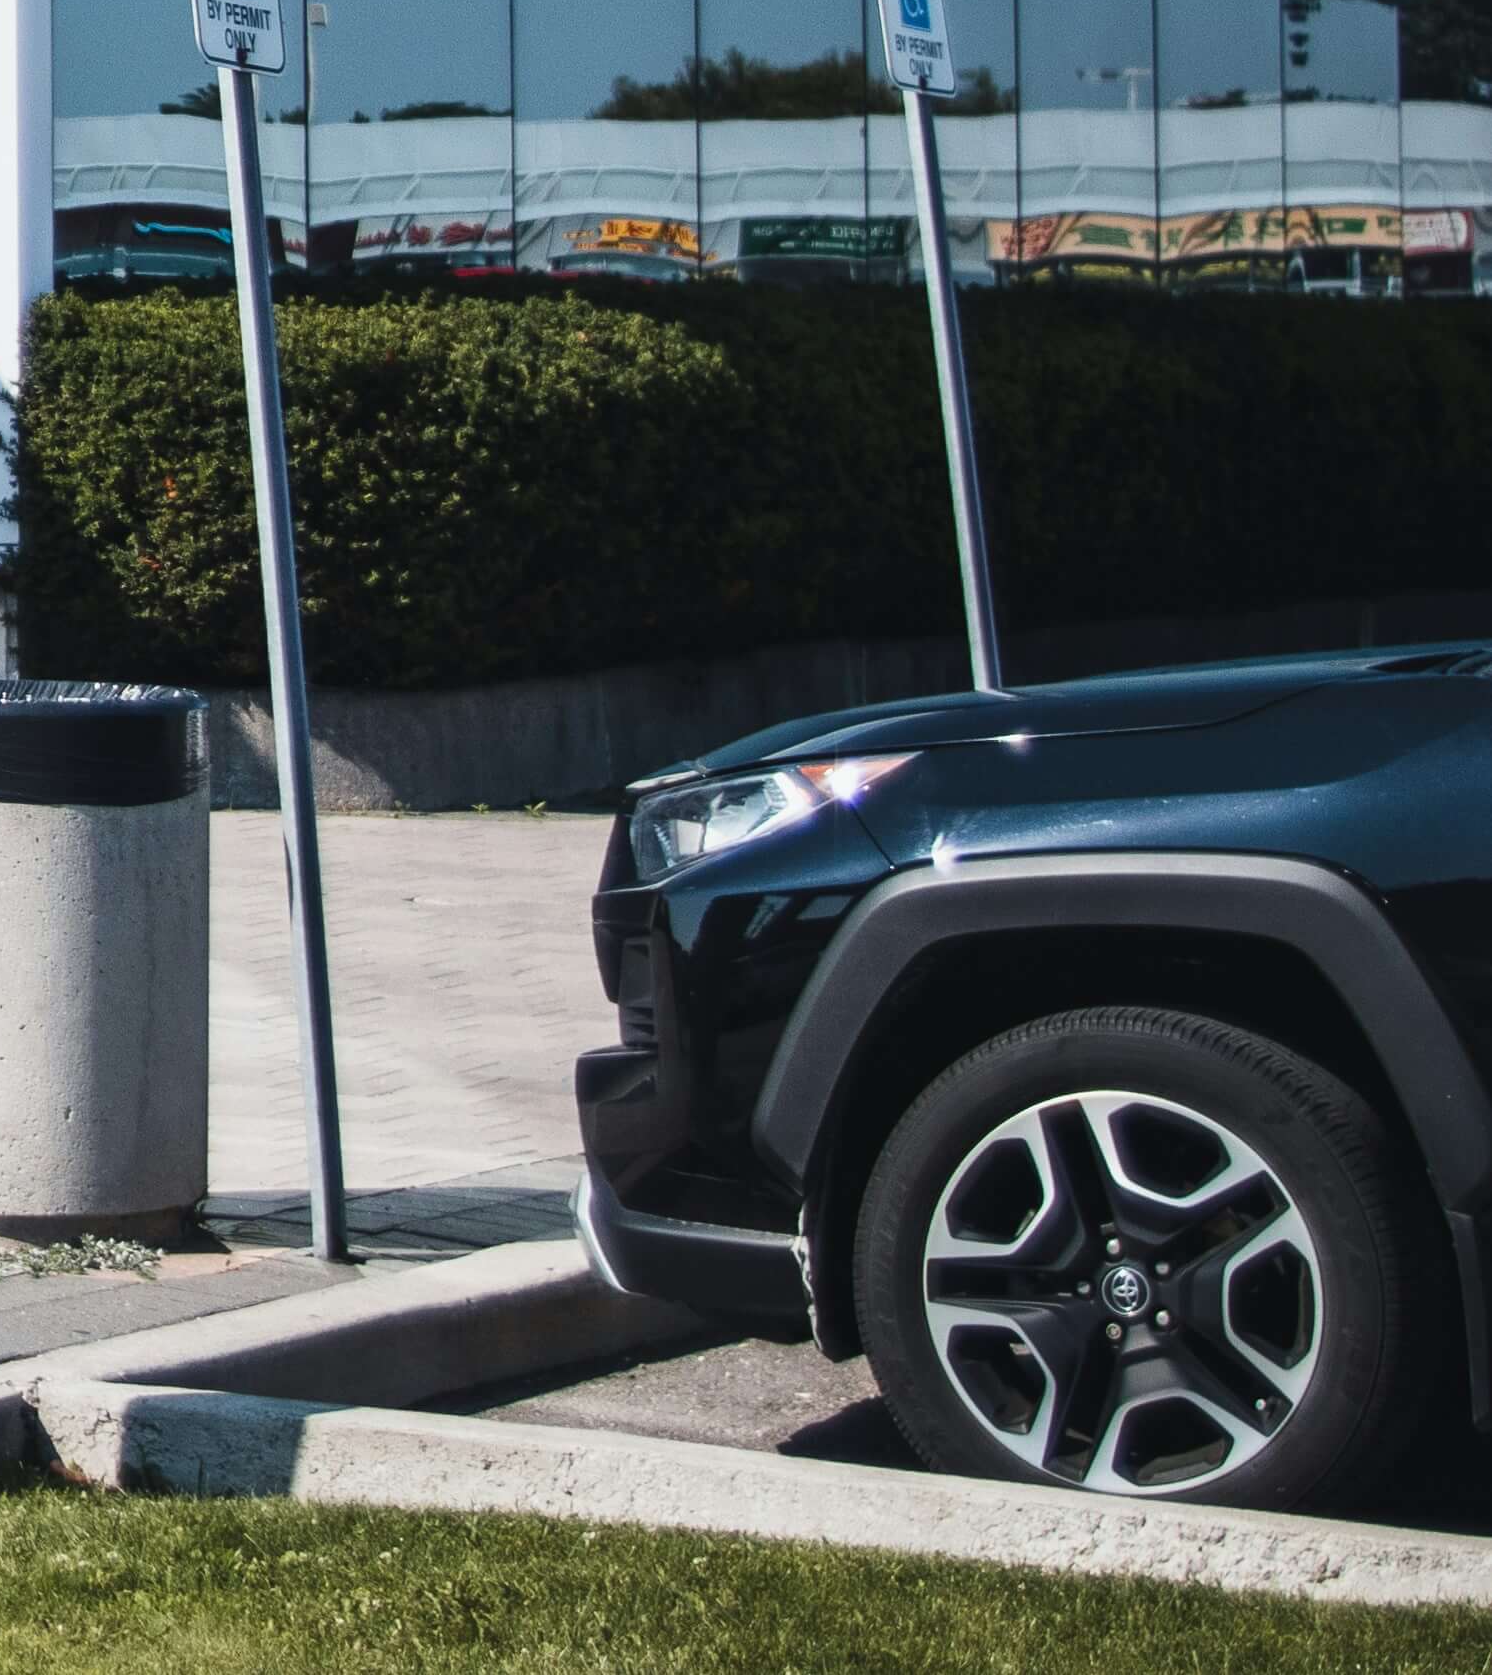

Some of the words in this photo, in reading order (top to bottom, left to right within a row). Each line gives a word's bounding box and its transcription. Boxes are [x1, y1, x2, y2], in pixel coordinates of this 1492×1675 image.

[225, 2, 271, 30] PERMIT
[225, 31, 257, 52] ONLY
[895, 33, 906, 52] BY
[909, 36, 943, 60] PERMIT
[909, 59, 933, 78] ONLY
